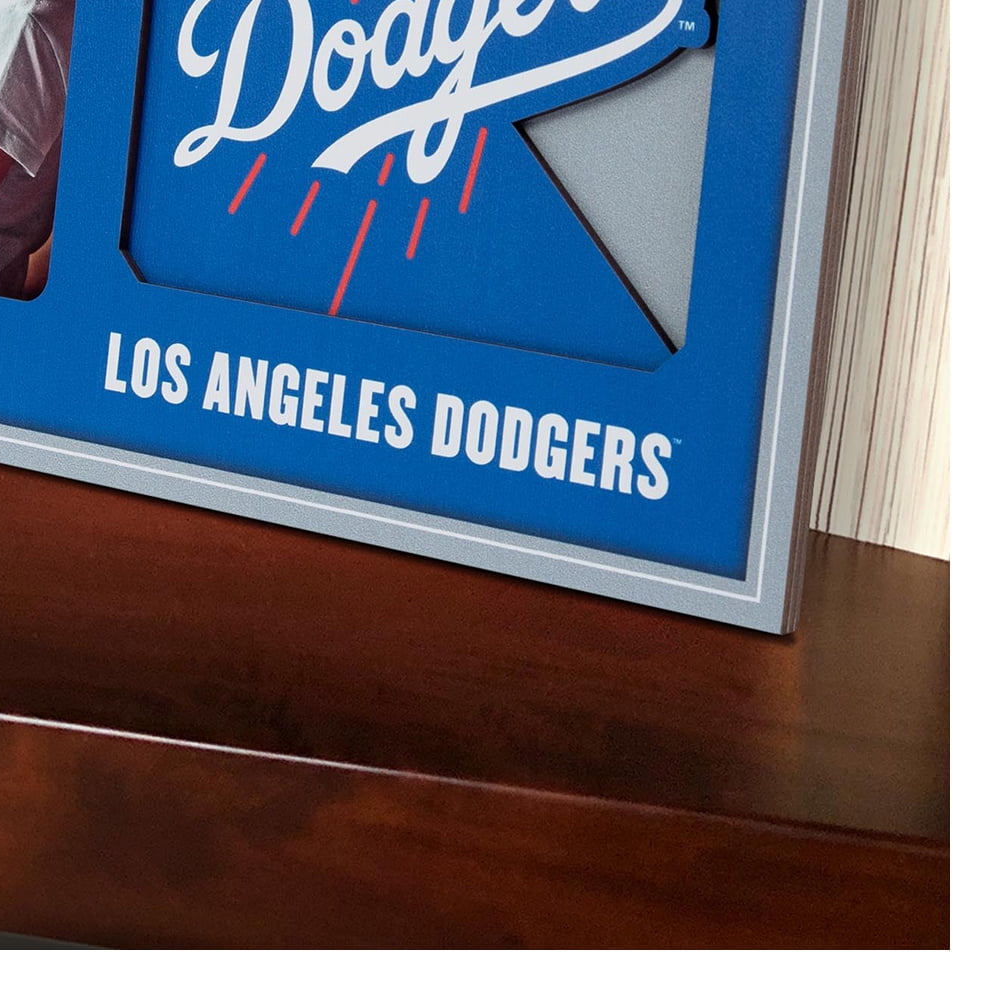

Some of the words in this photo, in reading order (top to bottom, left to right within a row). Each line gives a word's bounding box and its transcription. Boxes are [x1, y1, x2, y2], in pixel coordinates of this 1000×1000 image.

[104, 332, 191, 405] LOS
[202, 351, 417, 449] ANGELES
[431, 393, 672, 500] DODGERS
